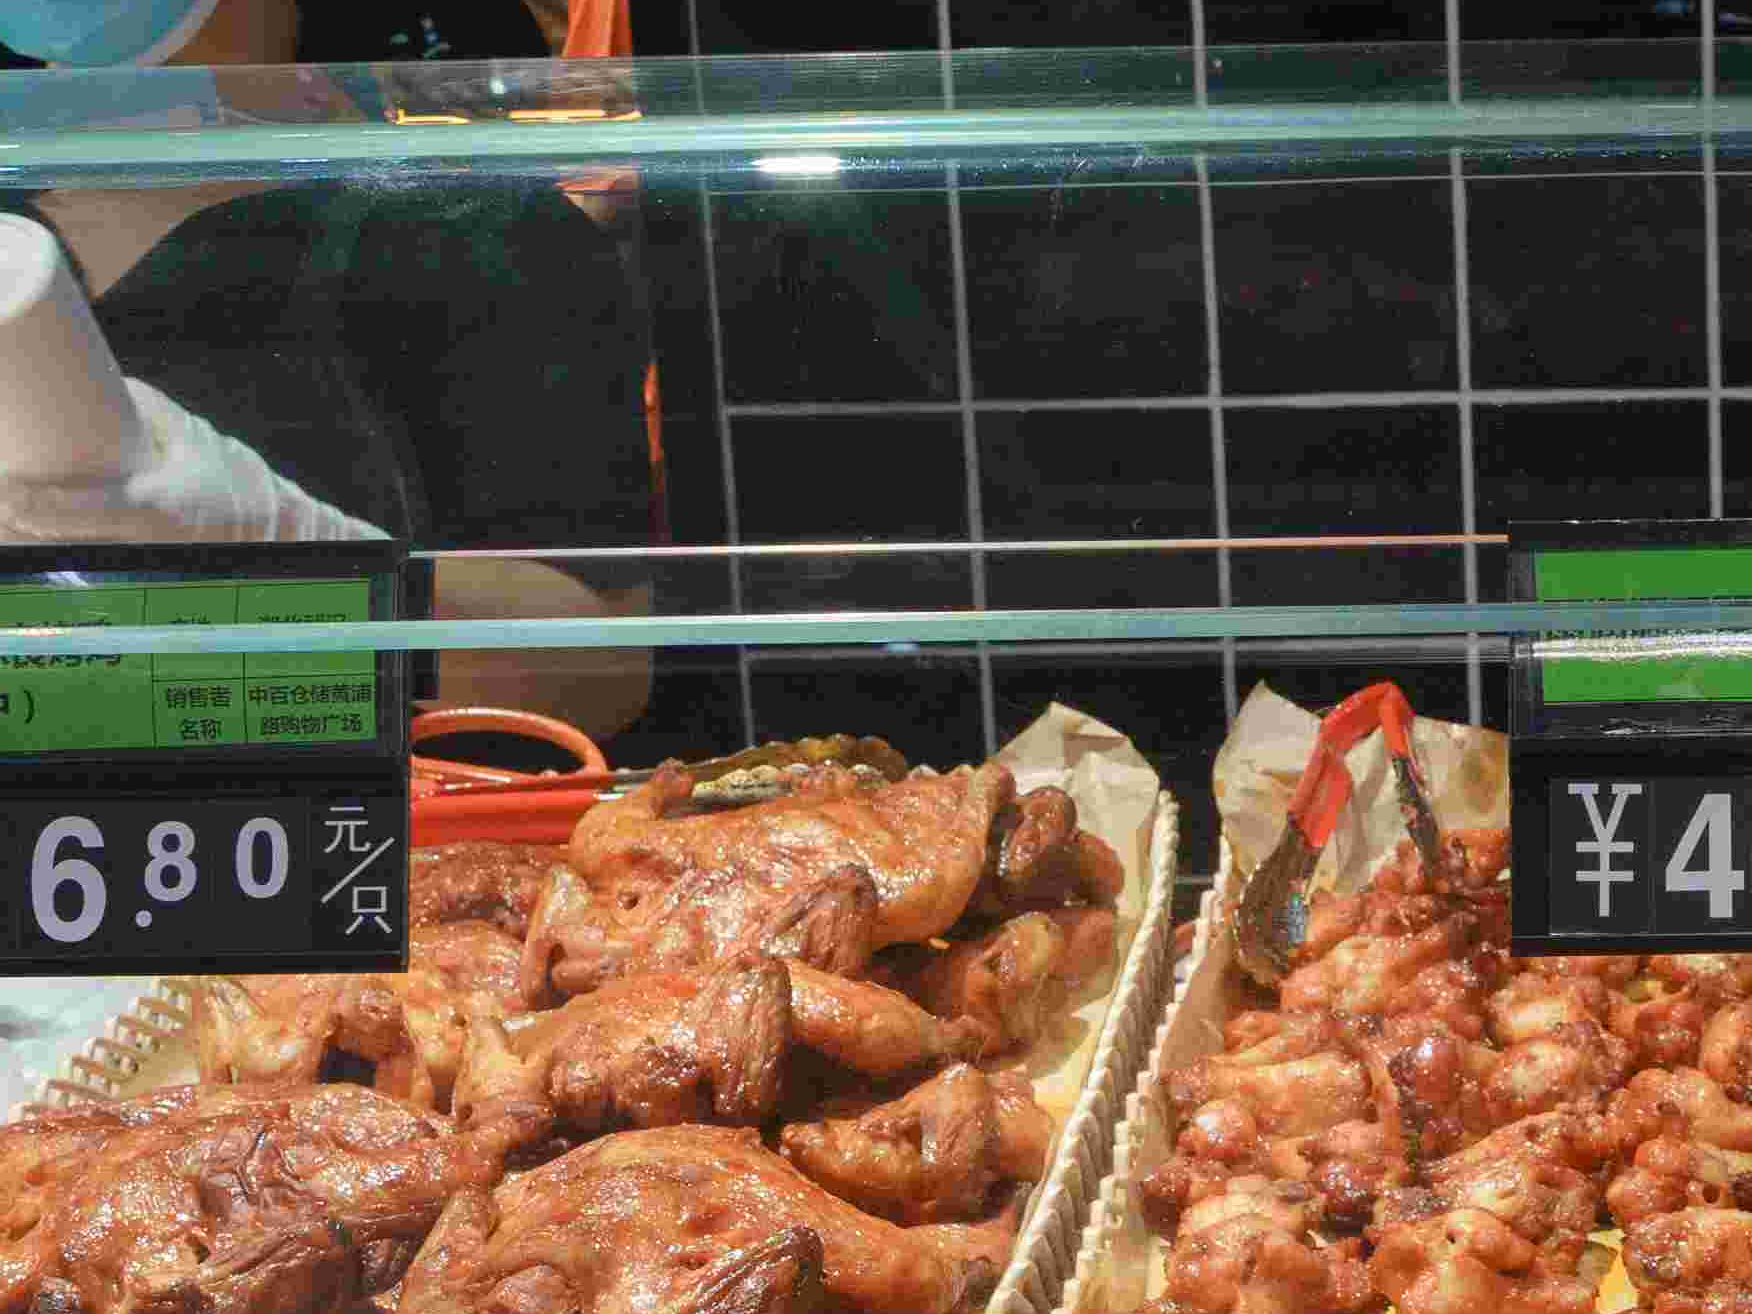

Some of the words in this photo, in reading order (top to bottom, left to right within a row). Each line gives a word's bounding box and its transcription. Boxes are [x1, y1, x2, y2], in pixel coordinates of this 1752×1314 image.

[165, 684, 233, 710] 销售者
[179, 716, 222, 741] 名称
